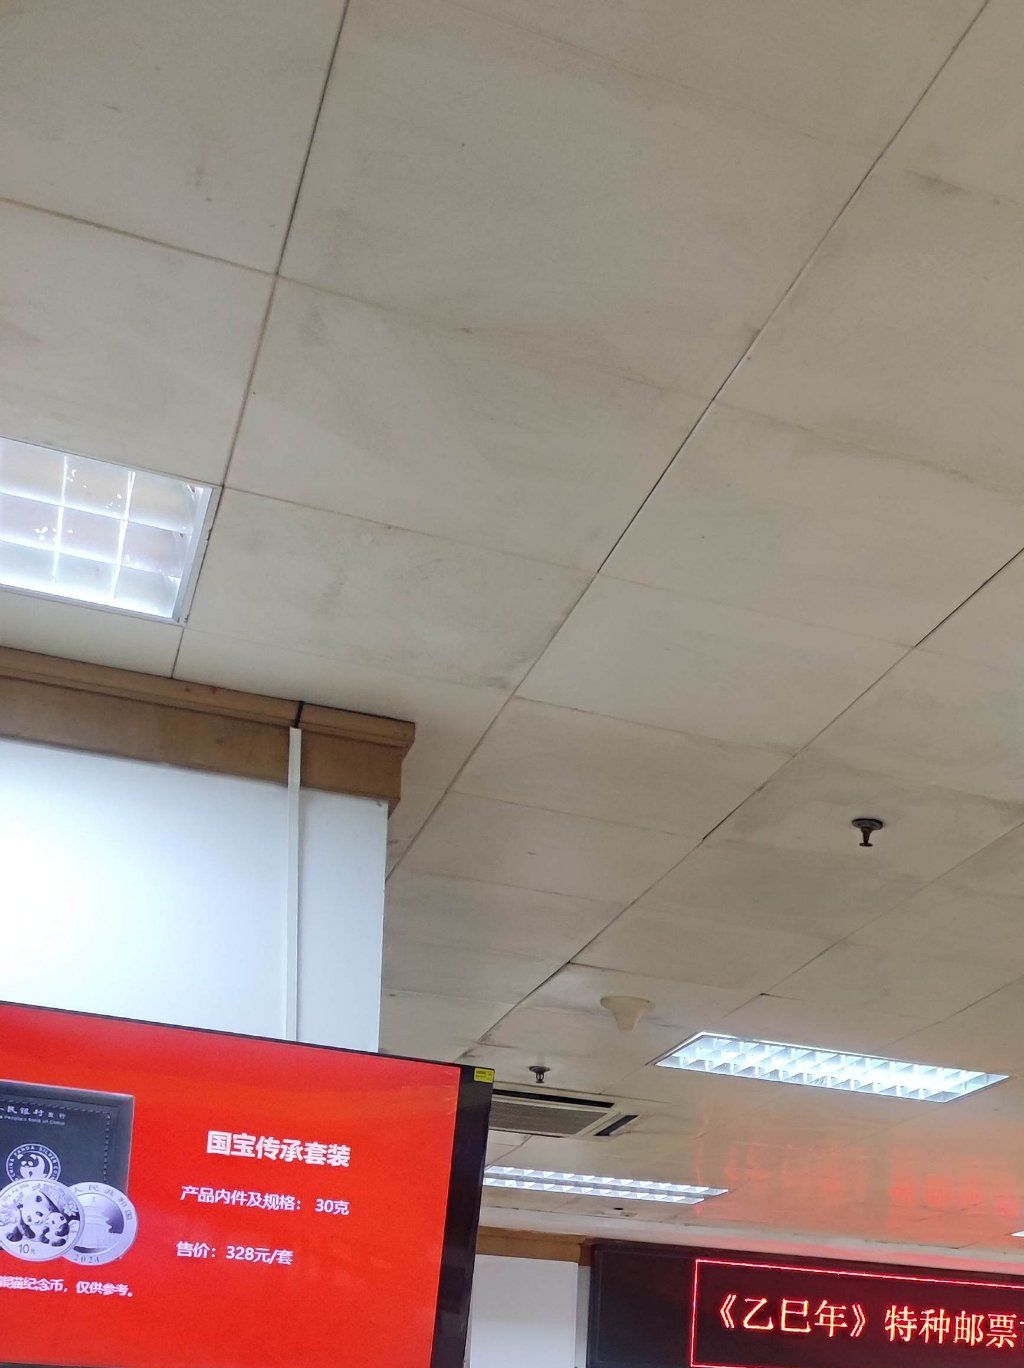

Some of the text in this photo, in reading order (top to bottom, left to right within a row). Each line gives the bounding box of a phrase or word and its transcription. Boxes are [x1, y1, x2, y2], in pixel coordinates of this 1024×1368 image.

[206, 1130, 352, 1168] 国宝传承套装
[315, 1198, 351, 1216] 30克
